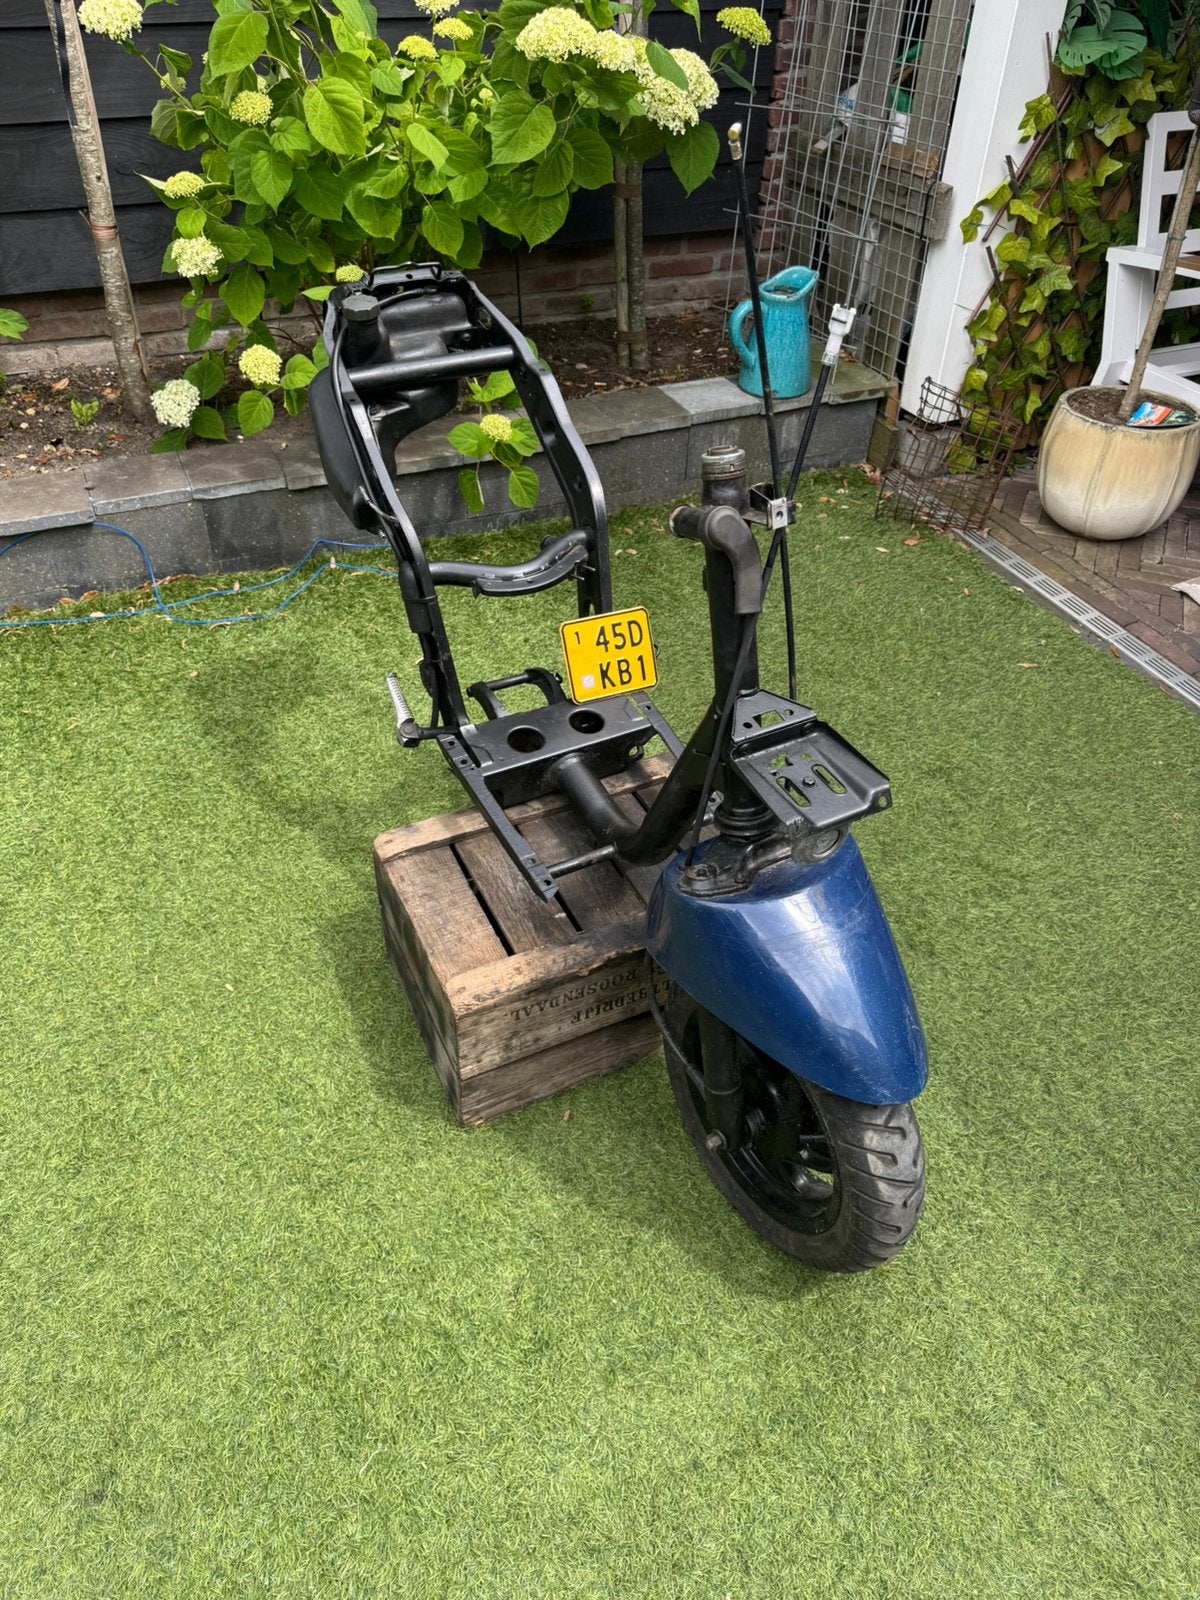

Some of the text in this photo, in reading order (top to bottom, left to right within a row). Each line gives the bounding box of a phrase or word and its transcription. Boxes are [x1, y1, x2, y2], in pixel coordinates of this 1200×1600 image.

[574, 620, 643, 652] 1 45D
[599, 655, 646, 689] KB1
